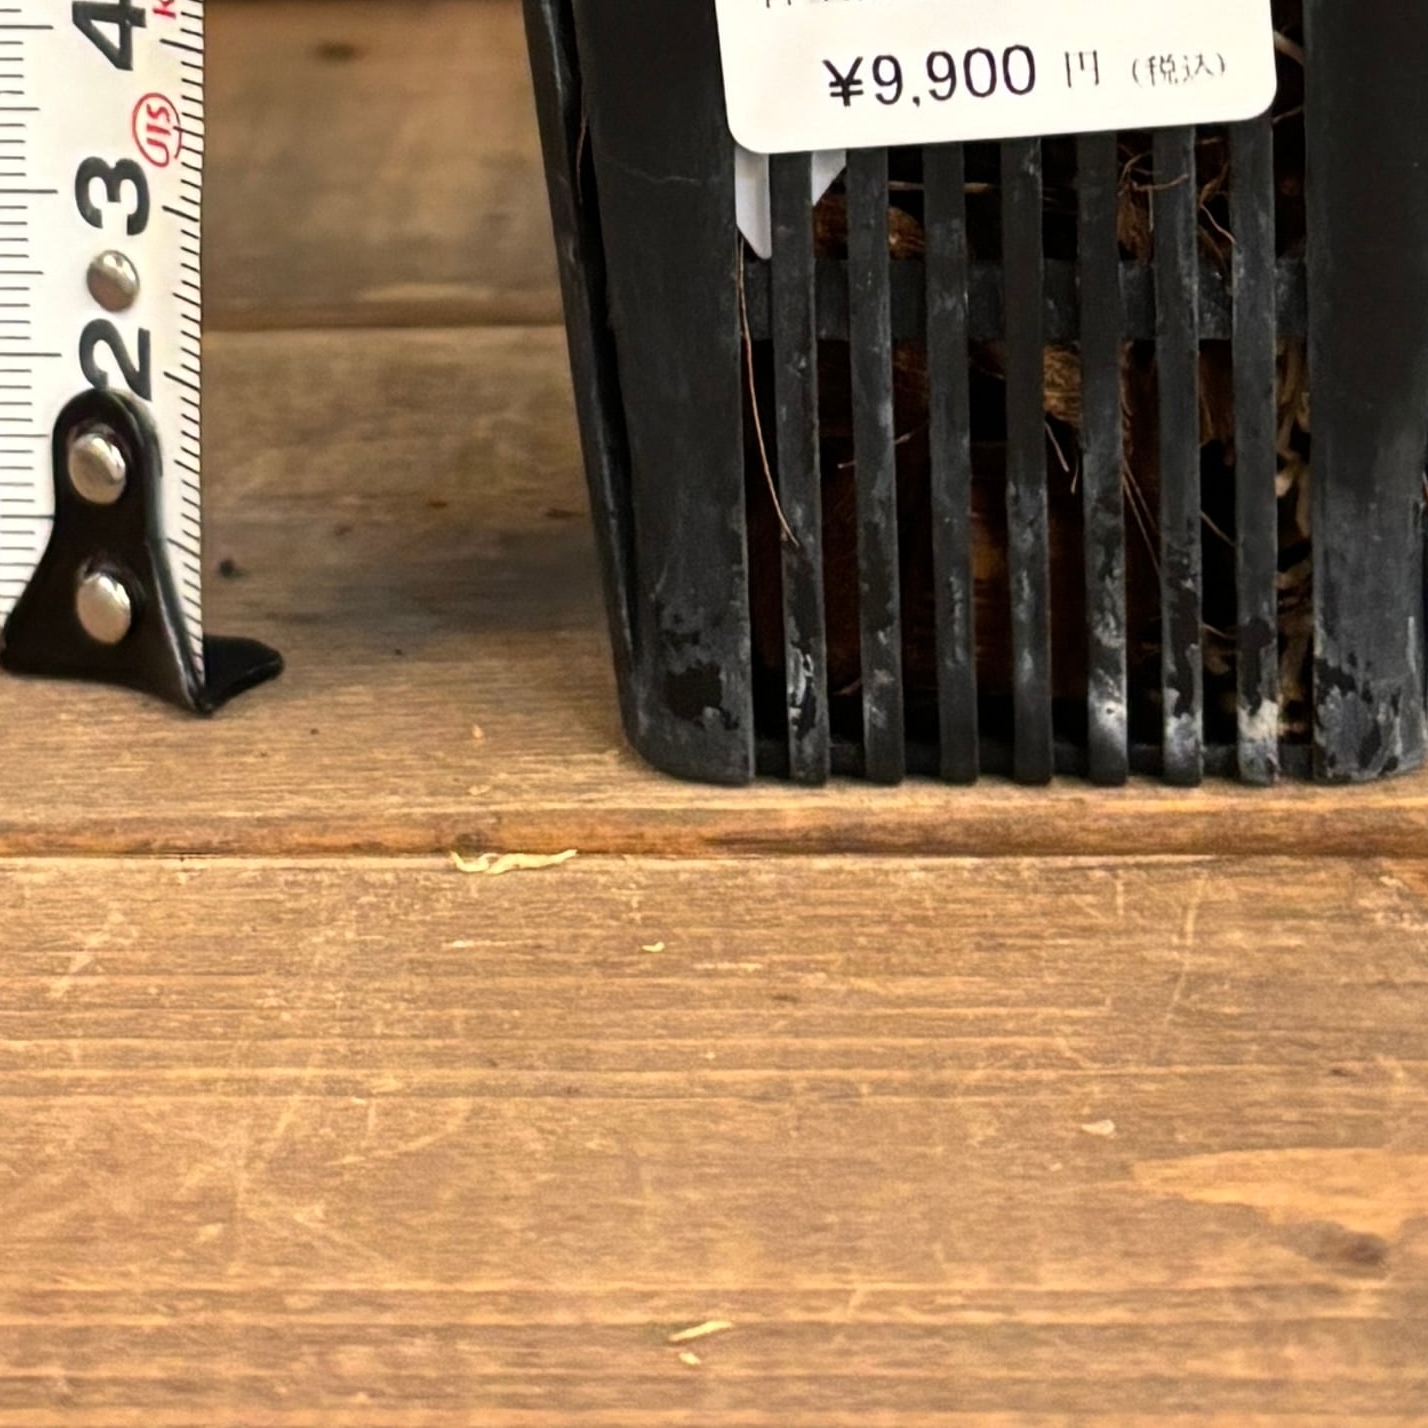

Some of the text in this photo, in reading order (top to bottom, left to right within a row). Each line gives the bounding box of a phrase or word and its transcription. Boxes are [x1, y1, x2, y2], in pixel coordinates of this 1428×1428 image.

[822, 44, 1037, 107] ¥9,900
[74, 156, 151, 237] 3
[78, 318, 152, 402] 2
